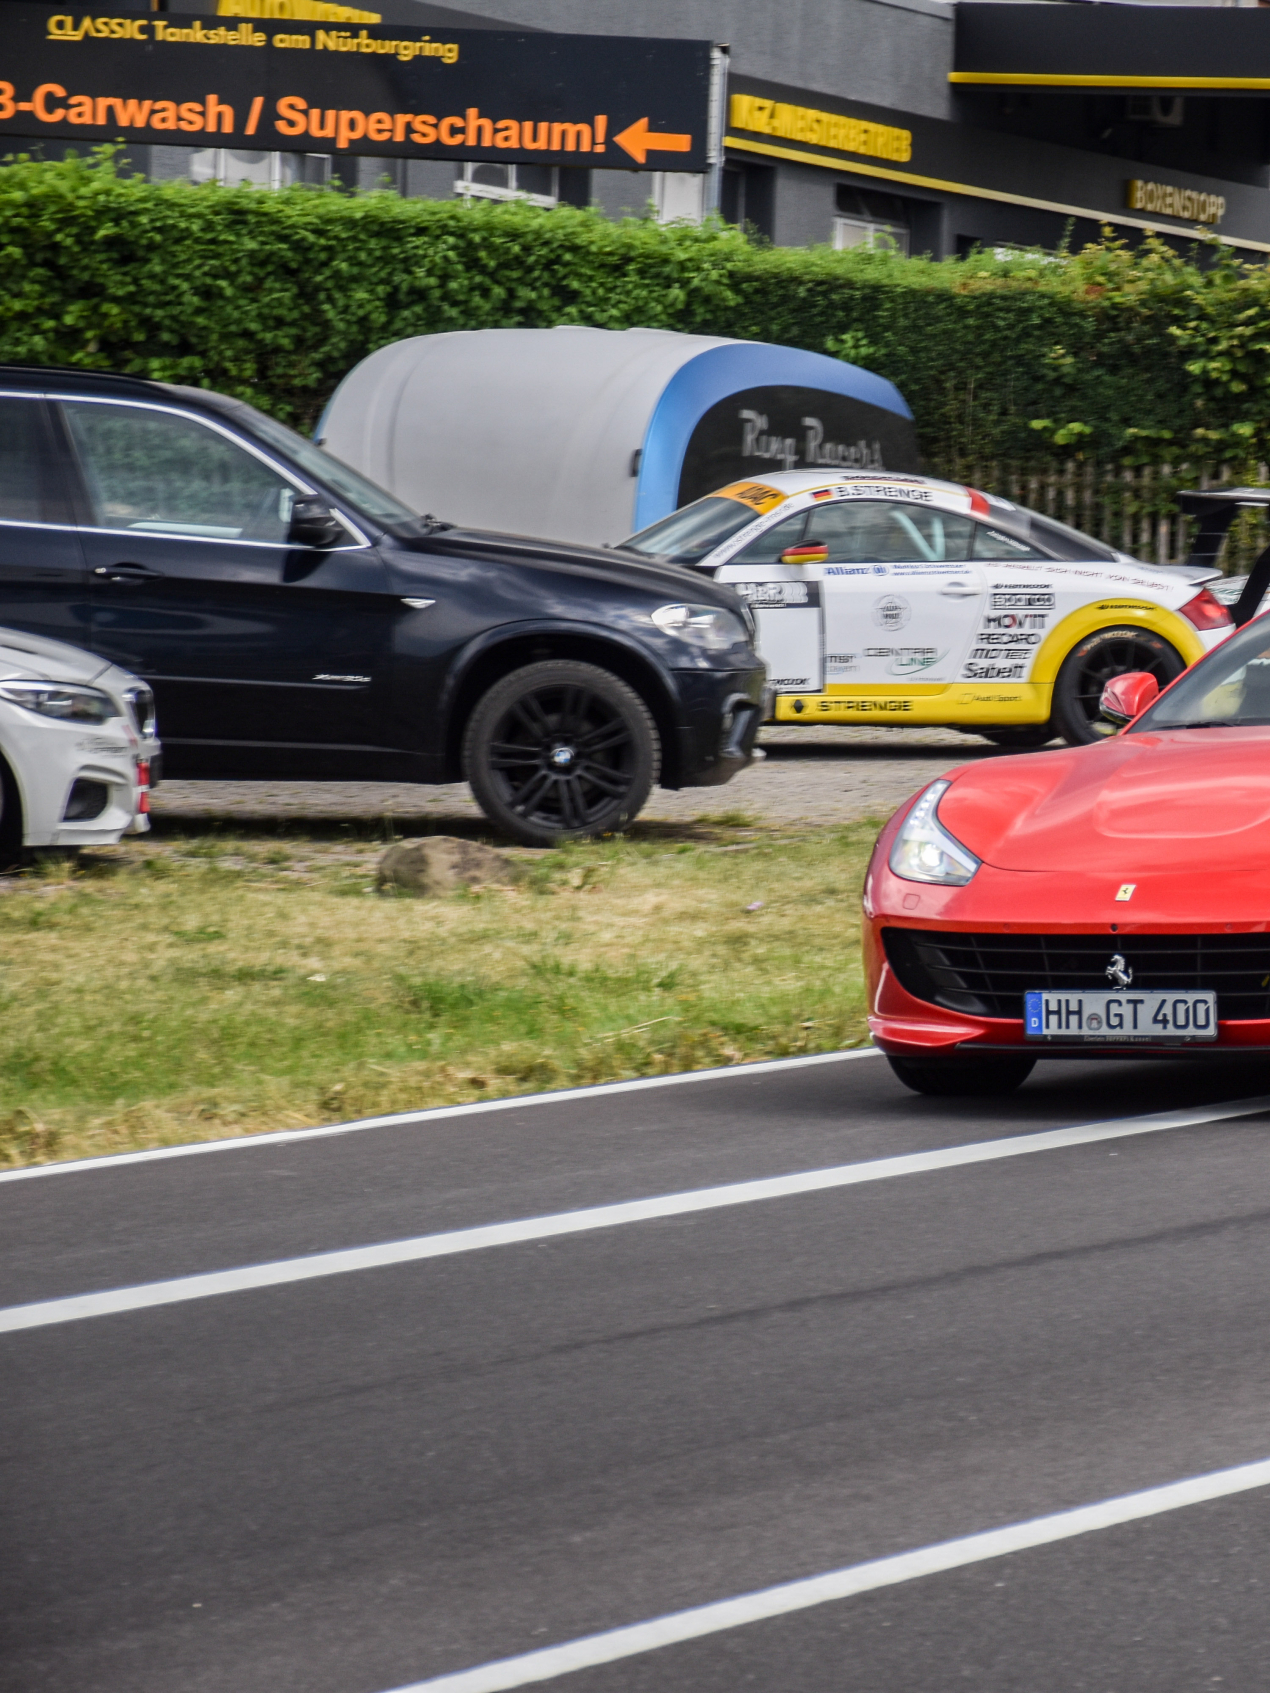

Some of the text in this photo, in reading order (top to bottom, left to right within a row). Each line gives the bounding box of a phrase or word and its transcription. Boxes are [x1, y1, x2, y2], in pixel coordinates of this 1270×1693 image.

[47, 15, 460, 64] CLASSIC Tankstelle am Nürburgring
[275, 95, 608, 153] Superschaum!
[1129, 180, 1226, 224] BOXENSTOPP
[823, 566, 869, 576] Allianz
[976, 633, 1042, 645] RECARO
[962, 662, 1027, 679] Sabelt
[1031, 1017, 1039, 1028] D
[1045, 999, 1210, 1030] HH GT 400
